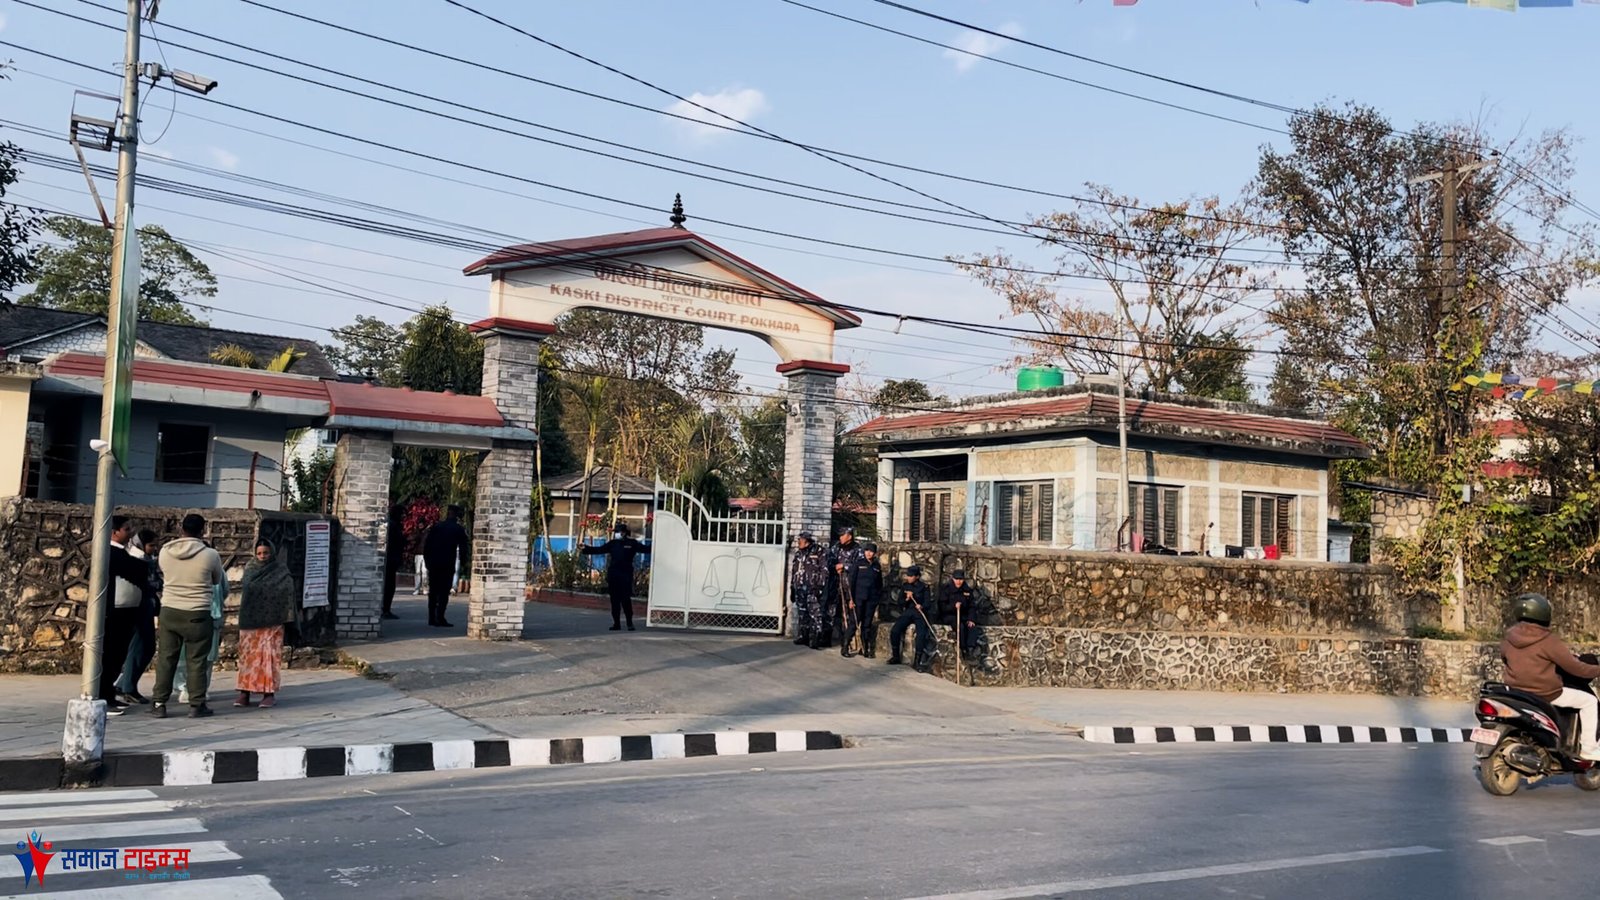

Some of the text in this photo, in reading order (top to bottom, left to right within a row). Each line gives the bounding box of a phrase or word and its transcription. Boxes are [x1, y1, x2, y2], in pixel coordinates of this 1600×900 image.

[550, 283, 601, 302] KASKI
[605, 292, 681, 315] DISTRICT
[740, 314, 801, 334] POKHARA
